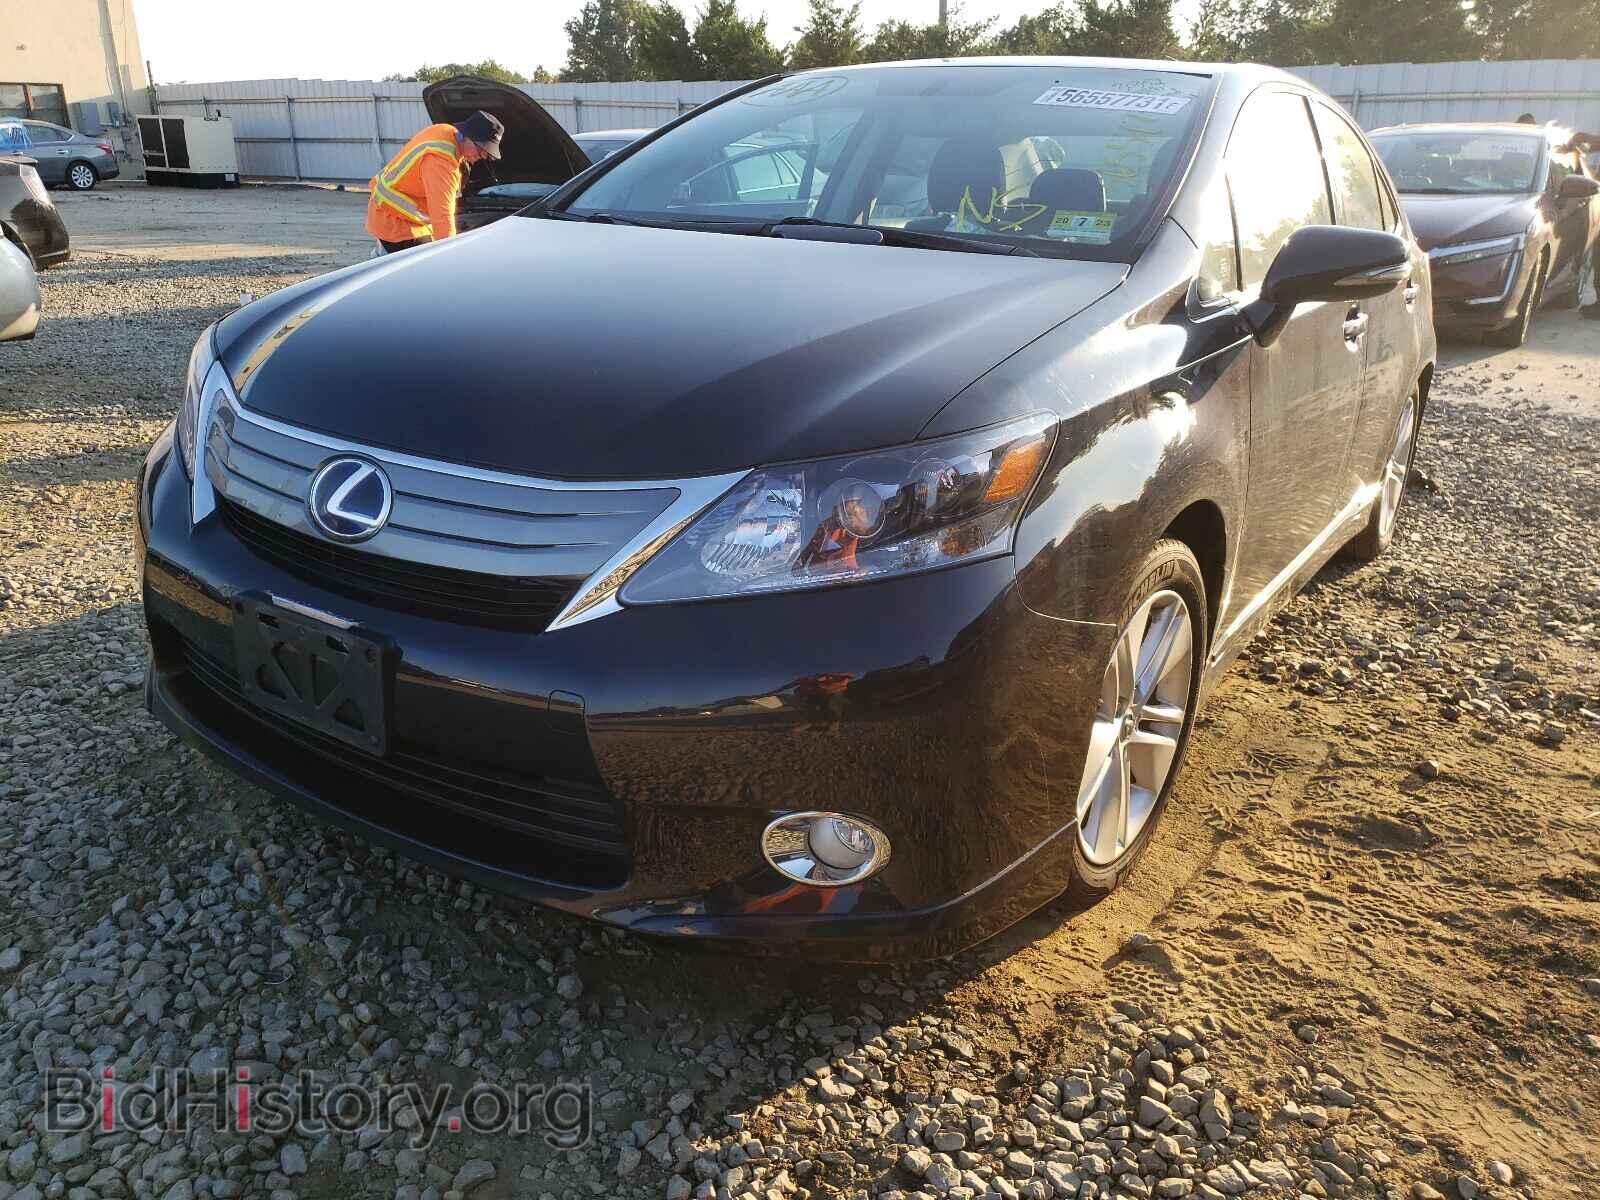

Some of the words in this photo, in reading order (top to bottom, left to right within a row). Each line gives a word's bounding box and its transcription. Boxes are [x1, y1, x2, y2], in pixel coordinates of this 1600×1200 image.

[1055, 88, 1166, 109] 56557731
[1055, 217, 1069, 225] 20
[1078, 217, 1089, 227] 7
